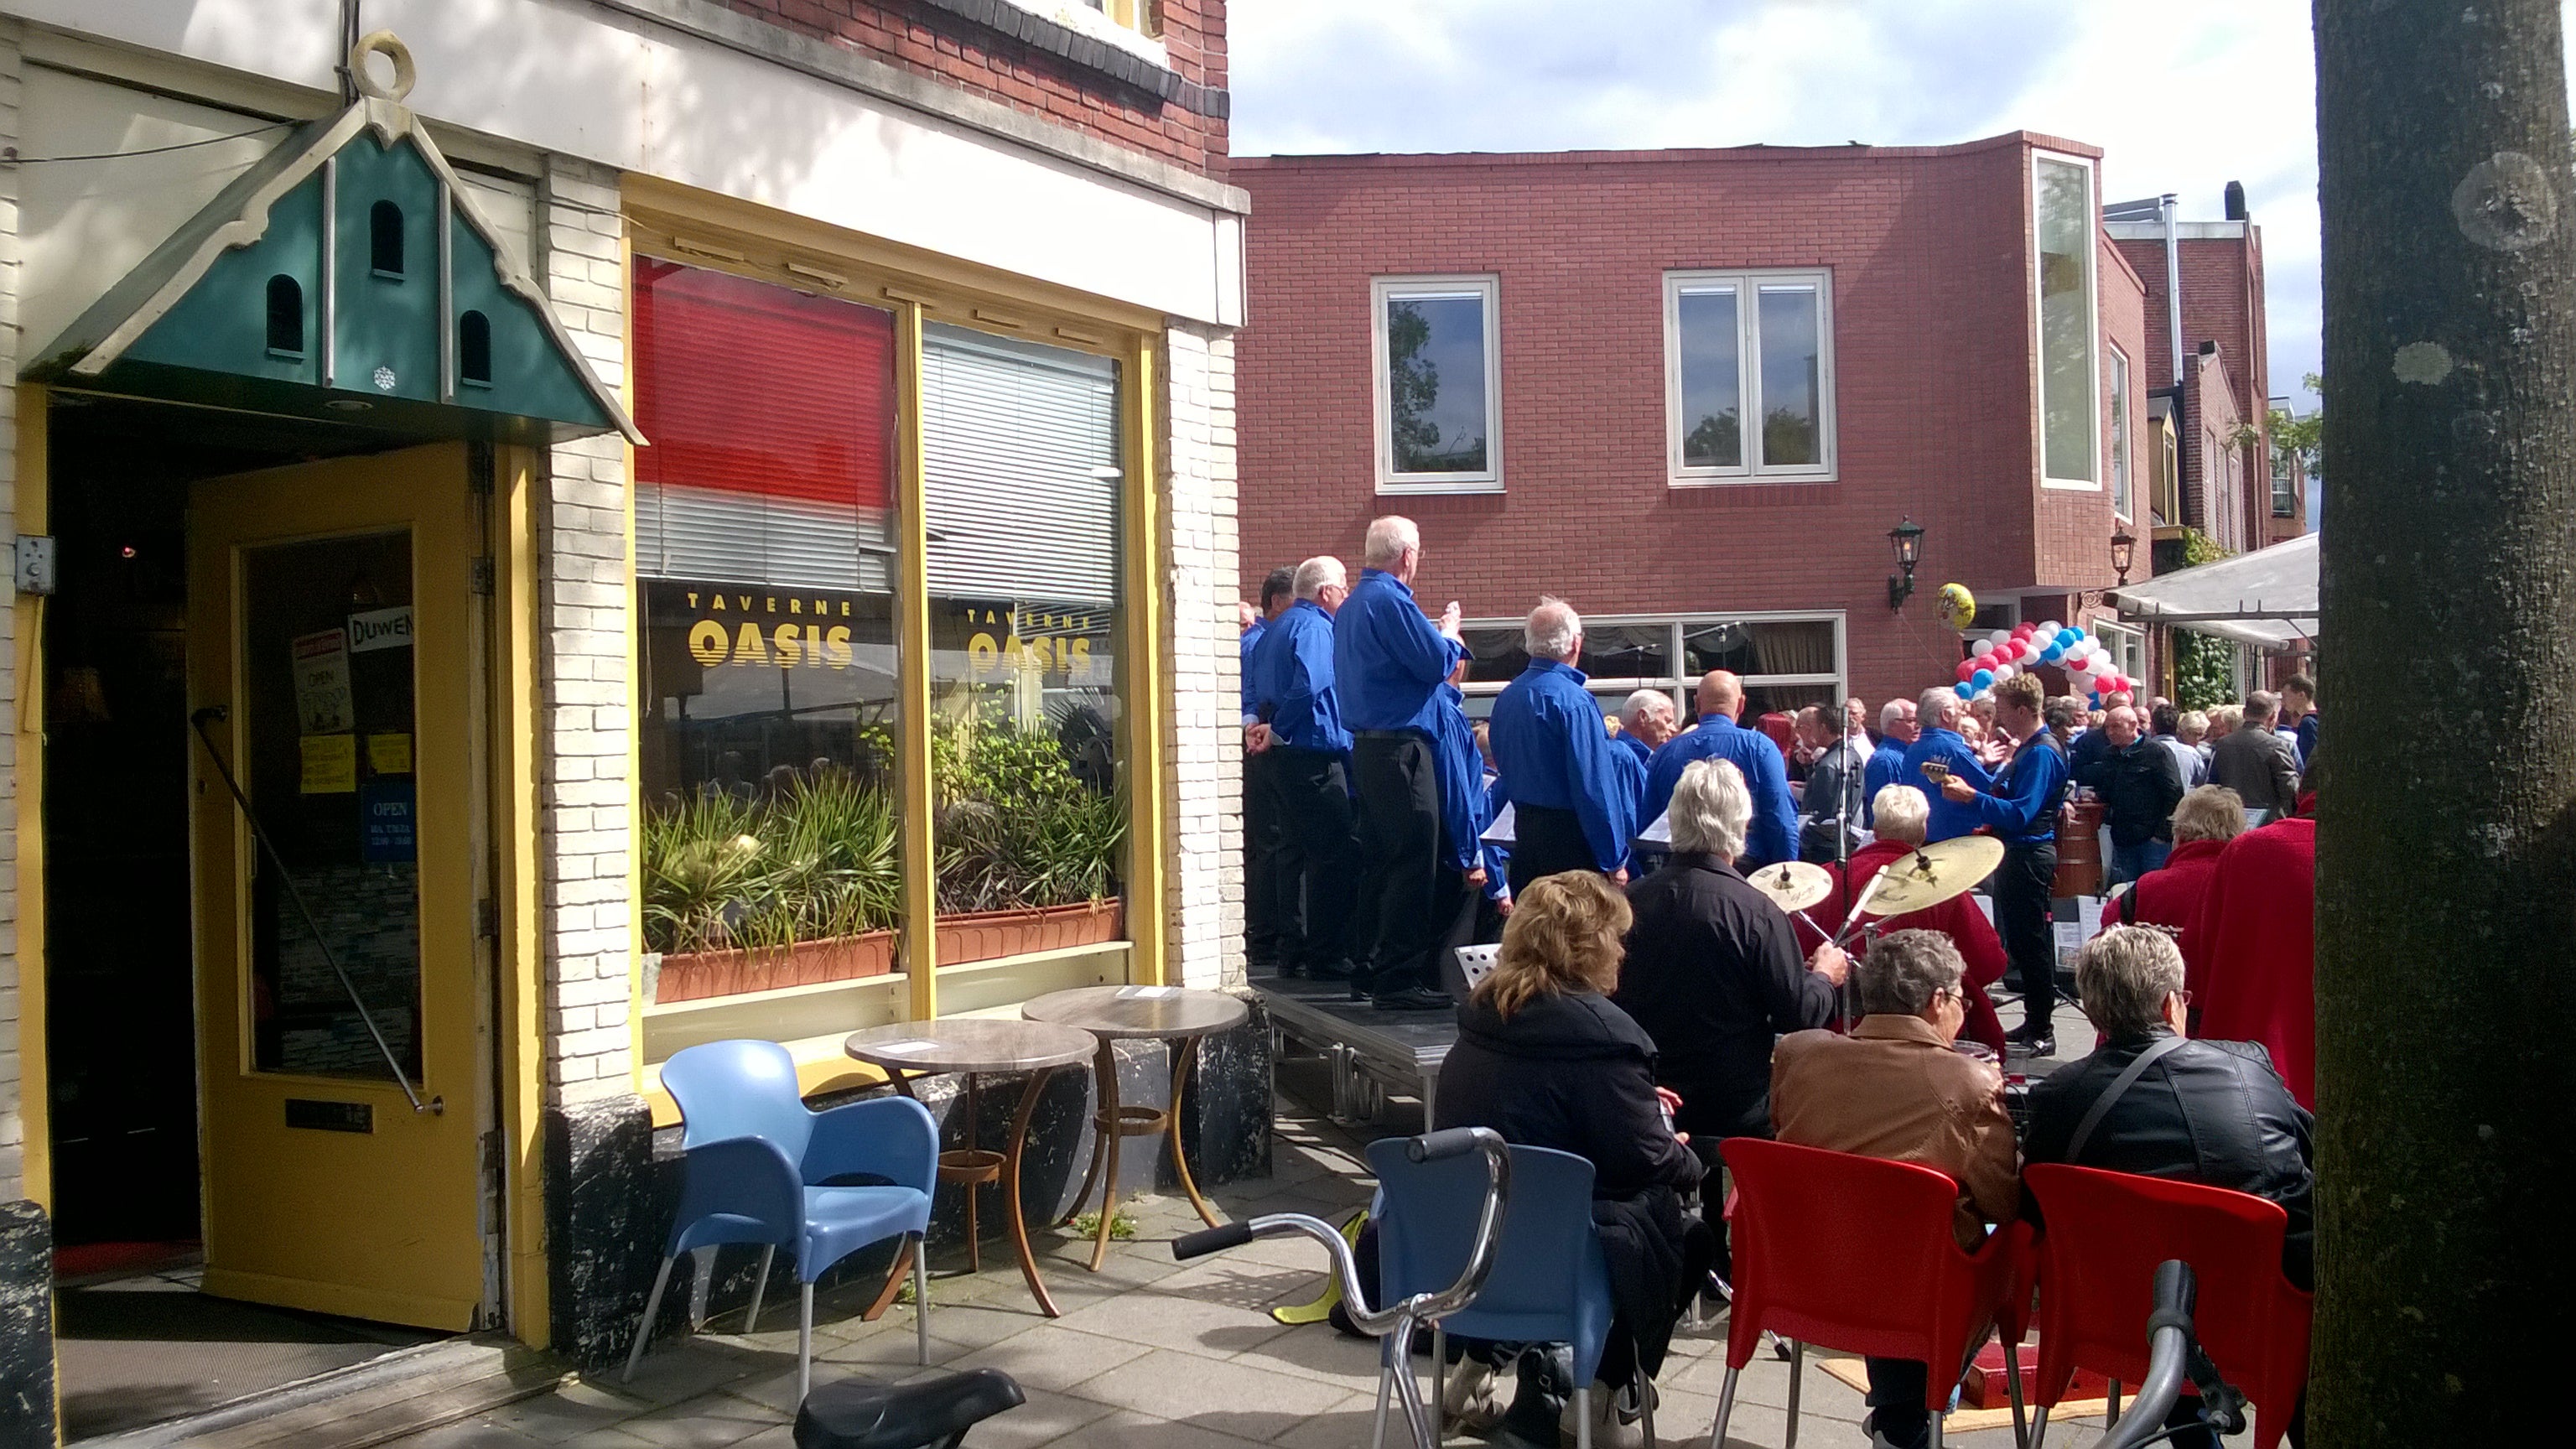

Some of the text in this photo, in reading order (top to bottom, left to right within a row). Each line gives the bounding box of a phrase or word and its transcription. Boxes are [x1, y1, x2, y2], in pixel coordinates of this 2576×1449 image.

[688, 592, 851, 617] TAVERNE
[967, 608, 1089, 629] TAVERNE
[688, 619, 854, 670] OASIS
[967, 631, 1092, 676] OASIS
[372, 802, 408, 817] OPEN
